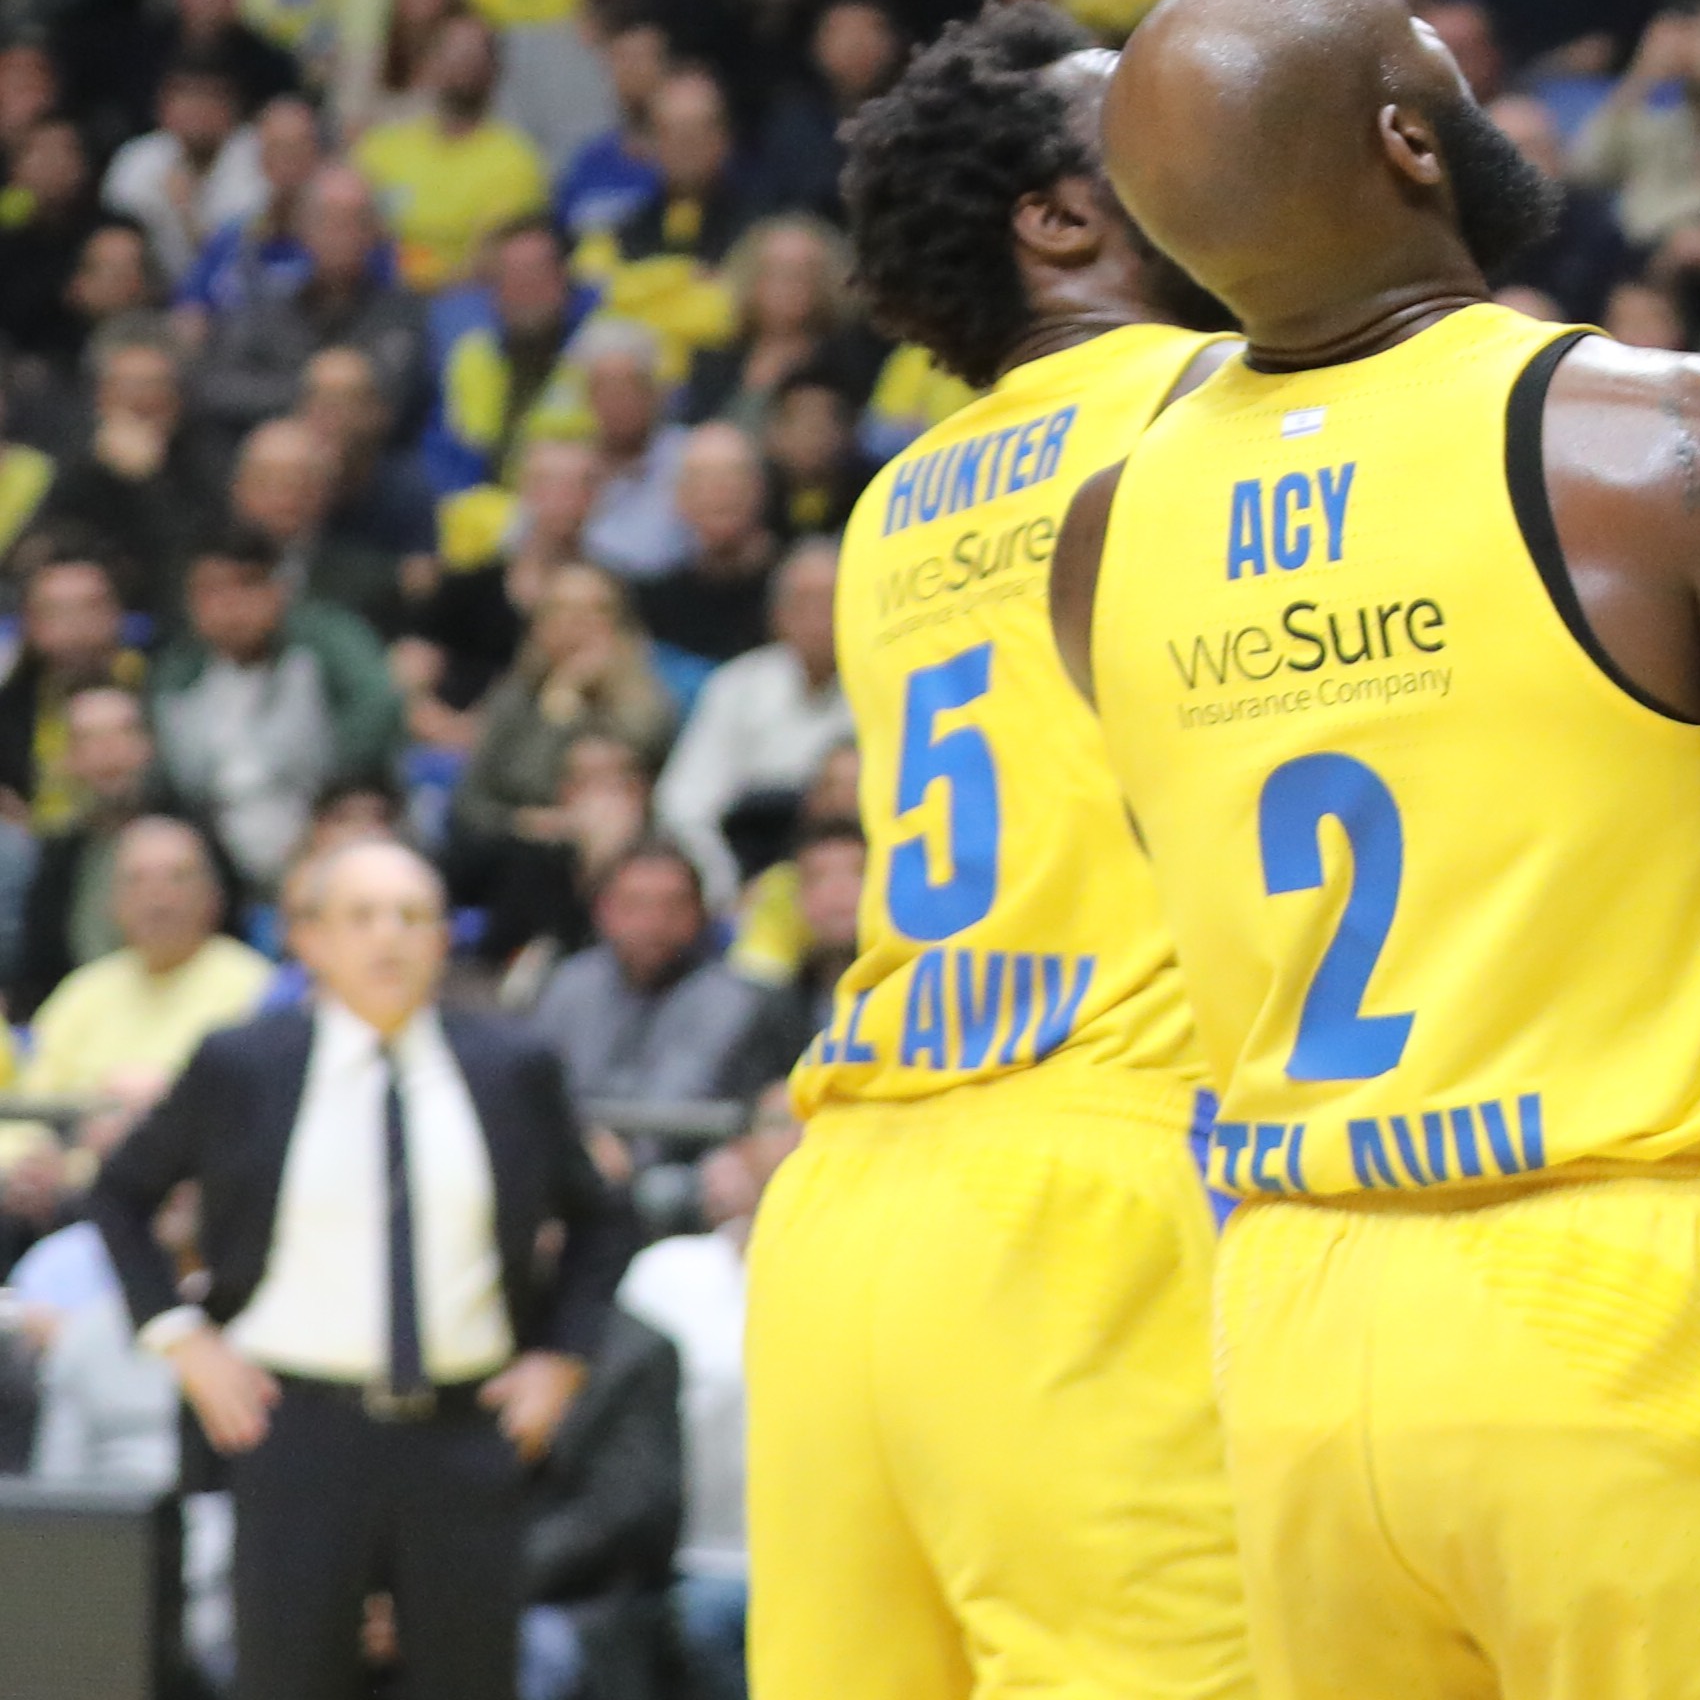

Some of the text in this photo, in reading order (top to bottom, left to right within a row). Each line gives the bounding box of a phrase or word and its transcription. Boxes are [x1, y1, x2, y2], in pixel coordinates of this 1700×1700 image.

[882, 403, 1078, 537] HUNTER
[1227, 462, 1357, 581] ACY
[1167, 596, 1447, 690] weSure
[1177, 666, 1453, 730] Insurance Company
[886, 641, 999, 941] 5
[1258, 751, 1416, 1082] 2
[899, 946, 1095, 1071] AVIV
[1346, 1091, 1546, 1189] AVIV
